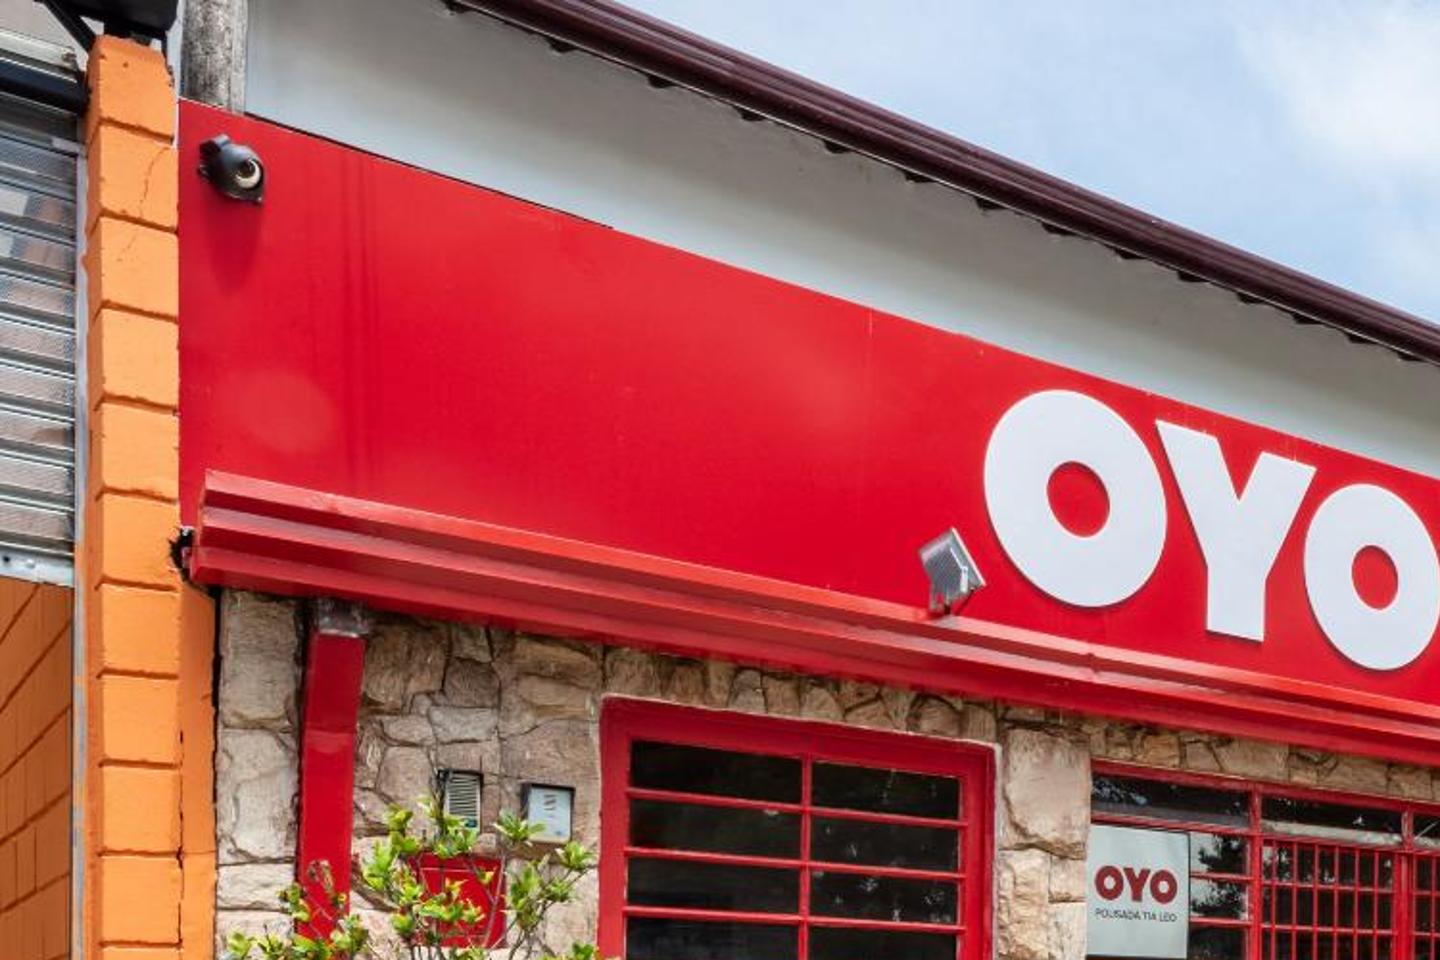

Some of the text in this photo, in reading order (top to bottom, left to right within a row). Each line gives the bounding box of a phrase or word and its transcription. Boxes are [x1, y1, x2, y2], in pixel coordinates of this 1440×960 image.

[1094, 865, 1178, 904] OYO
[1095, 907, 1141, 921] POUSADA
[1143, 911, 1157, 921] TIA
